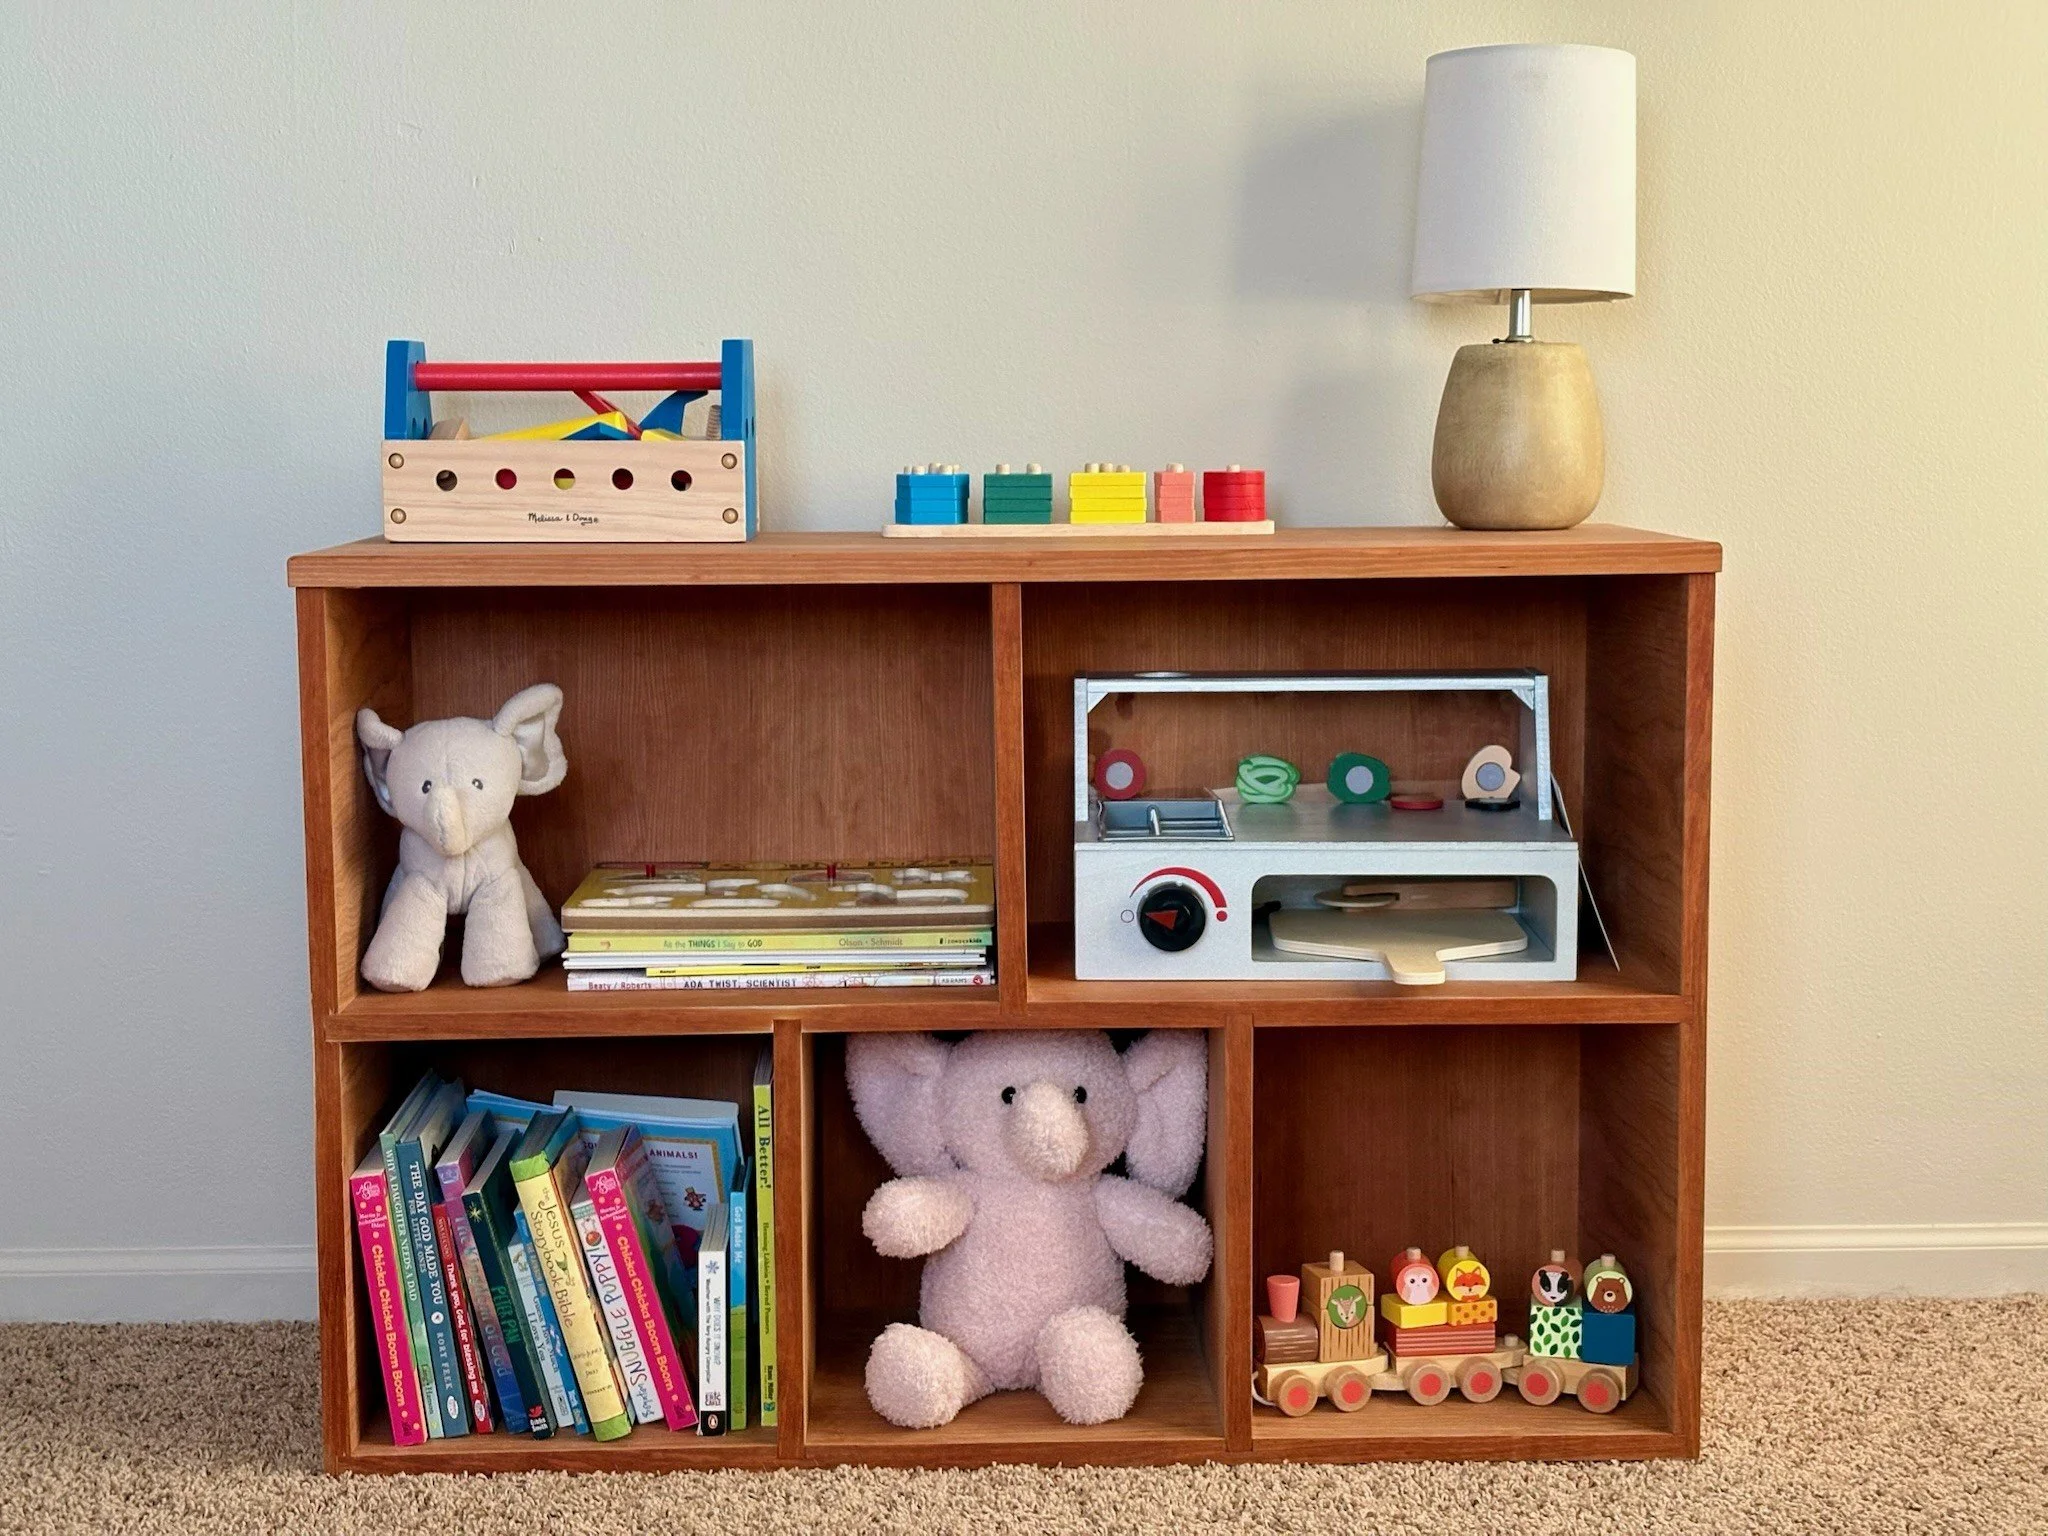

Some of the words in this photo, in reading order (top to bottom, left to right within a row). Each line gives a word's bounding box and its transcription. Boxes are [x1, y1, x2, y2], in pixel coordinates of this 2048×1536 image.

[528, 512, 563, 524] Melissa
[689, 939, 716, 949] THINGS
[723, 939, 736, 950] Say
[747, 938, 763, 948] GOD
[838, 938, 863, 946] Olson
[870, 937, 903, 946] Schmidt
[588, 982, 611, 990] Beaty
[620, 981, 652, 989] Roberts
[684, 980, 703, 989] ADA
[709, 979, 741, 989] TWIST,
[746, 978, 798, 988] SCIENTIST
[758, 1104, 771, 1128] All
[385, 1149, 397, 1171] WHY
[649, 1148, 699, 1160] ANIMALS!
[759, 1136, 772, 1190] Better!
[410, 1161, 422, 1189] THE
[390, 1183, 406, 1237] DAUGHTER
[408, 1199, 417, 1216] FOR
[414, 1190, 428, 1214] DAY
[735, 1206, 743, 1224] God
[411, 1217, 423, 1250] LITTLE
[419, 1216, 432, 1242] GOD
[455, 1216, 469, 1245] The
[537, 1200, 565, 1249] Jesus
[371, 1243, 387, 1288] Chicka
[401, 1238, 412, 1271] NEEDS
[417, 1251, 428, 1274] ONES
[423, 1243, 439, 1279] MADE
[446, 1262, 458, 1290] Thank
[530, 1211, 564, 1287] Storybook
[555, 1288, 576, 1329] Bible
[586, 1244, 623, 1305] PUPPY!
[407, 1280, 418, 1301] DAD
[430, 1280, 443, 1305] YOU
[497, 1285, 514, 1318] PETER
[379, 1288, 394, 1332] Chicka
[455, 1309, 466, 1329] God,
[617, 1235, 637, 1277] Chicka
[631, 1277, 651, 1320] Chicka
[645, 1319, 662, 1356] Boom
[656, 1355, 674, 1392] Boom
[436, 1331, 448, 1359] RORY
[459, 1328, 469, 1343] for
[484, 1323, 497, 1340] of
[503, 1319, 522, 1344] PAN
[529, 1318, 540, 1341] Love
[537, 1342, 546, 1362] You
[385, 1332, 400, 1369] Boom
[610, 1307, 649, 1387] SNUGGLE
[441, 1362, 453, 1390] FEEK
[463, 1343, 477, 1381] blessing
[490, 1346, 513, 1378] God
[392, 1370, 406, 1408] Boom
[425, 1386, 434, 1415] Hanson
[470, 1380, 480, 1395] me
